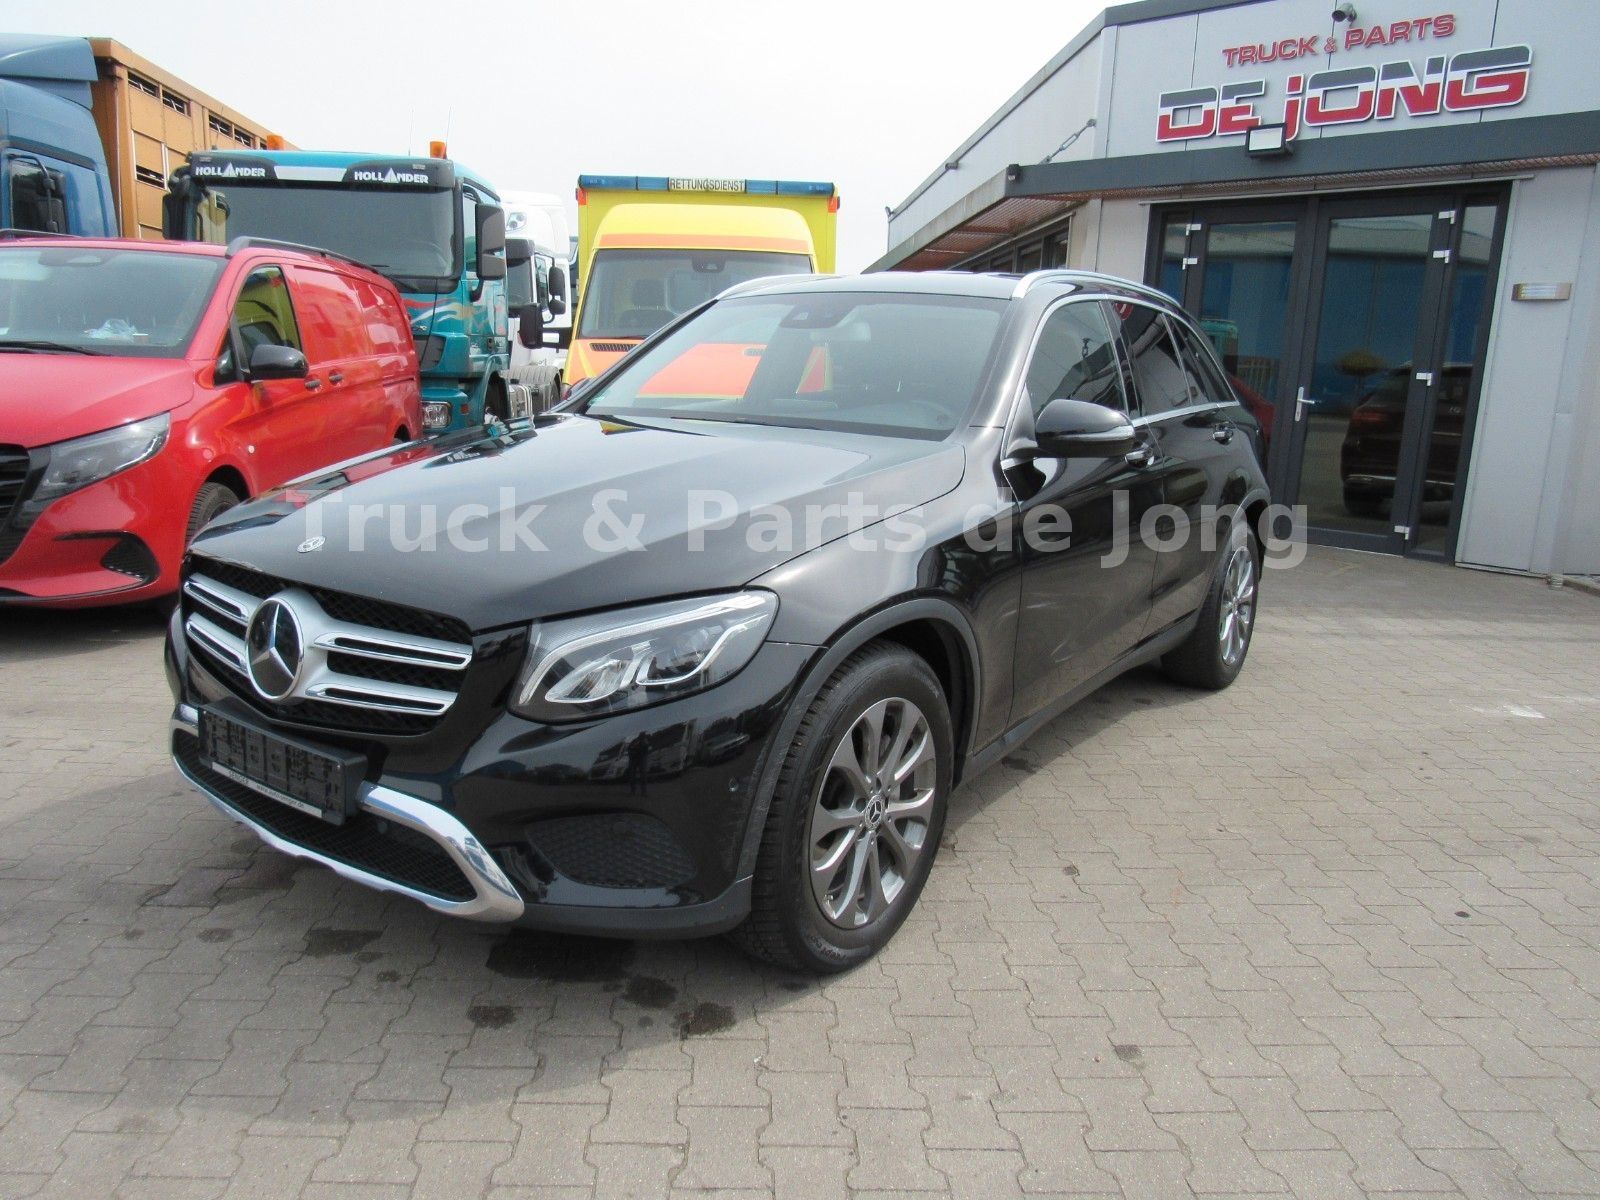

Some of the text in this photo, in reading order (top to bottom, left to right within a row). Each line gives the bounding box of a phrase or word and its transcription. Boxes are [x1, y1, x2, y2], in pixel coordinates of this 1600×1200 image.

[1222, 13, 1456, 68] TRUCK & PARTS
[1155, 77, 1267, 143] DE
[195, 161, 266, 178] HOLLANDER
[354, 167, 429, 184] HOLLANDER
[669, 178, 745, 192] RETTUNGSDIENST
